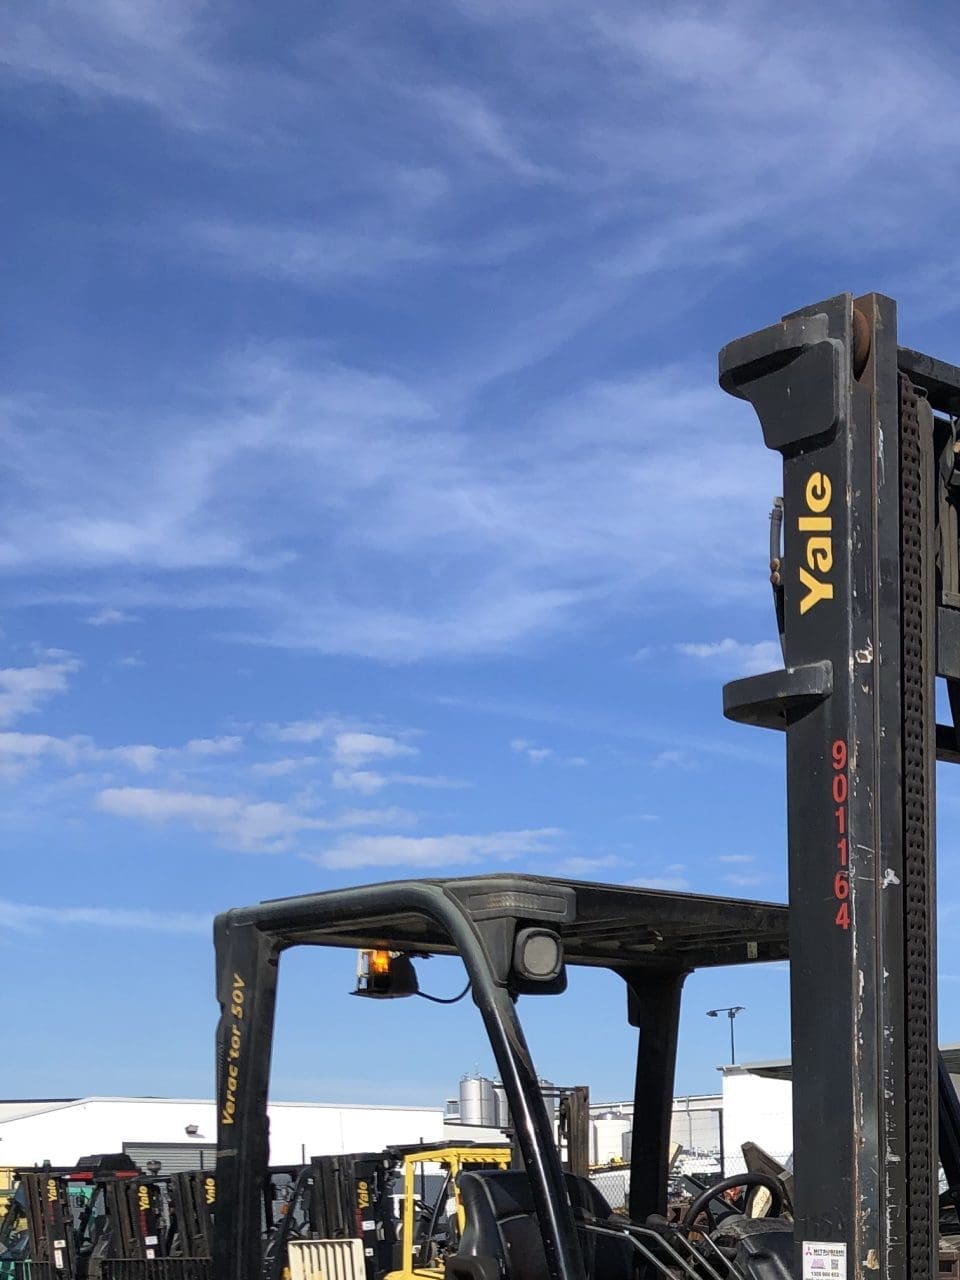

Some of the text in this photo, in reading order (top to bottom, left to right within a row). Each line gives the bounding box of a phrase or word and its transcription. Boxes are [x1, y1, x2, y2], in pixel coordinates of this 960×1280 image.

[798, 471, 834, 615] Yale
[831, 739, 851, 930] 901164
[222, 972, 247, 1126] Veractor 50V
[47, 1179, 58, 1202] Yale
[137, 1185, 150, 1211] Yale
[357, 1181, 370, 1209] Yale
